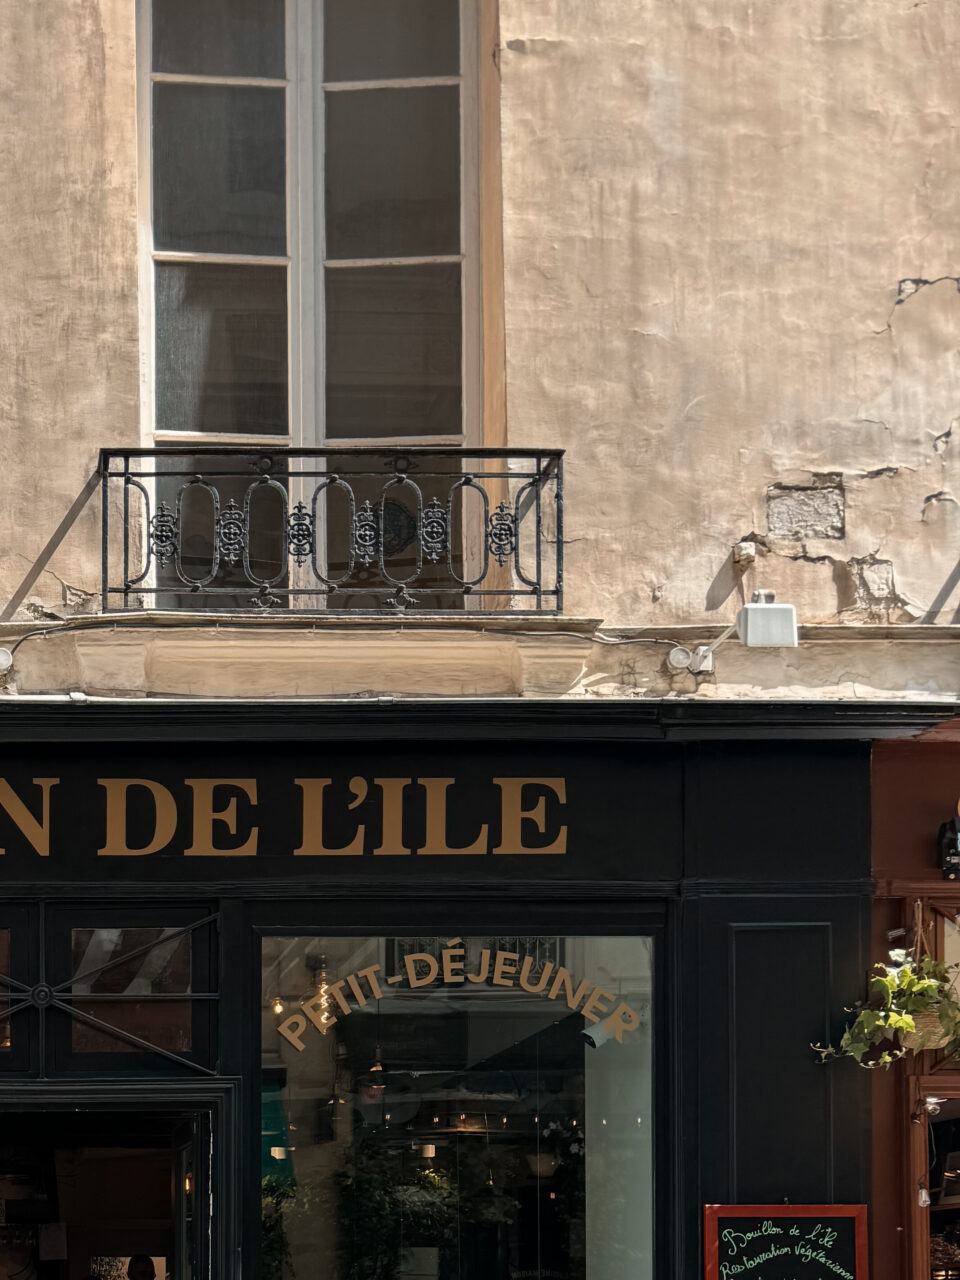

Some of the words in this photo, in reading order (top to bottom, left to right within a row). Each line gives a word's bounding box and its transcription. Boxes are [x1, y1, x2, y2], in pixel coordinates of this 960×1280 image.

[97, 777, 259, 856] DE
[277, 937, 640, 1052] PETIT-DÉJEUNER
[722, 1221, 783, 1255] Bouillon
[789, 1225, 800, 1235] de
